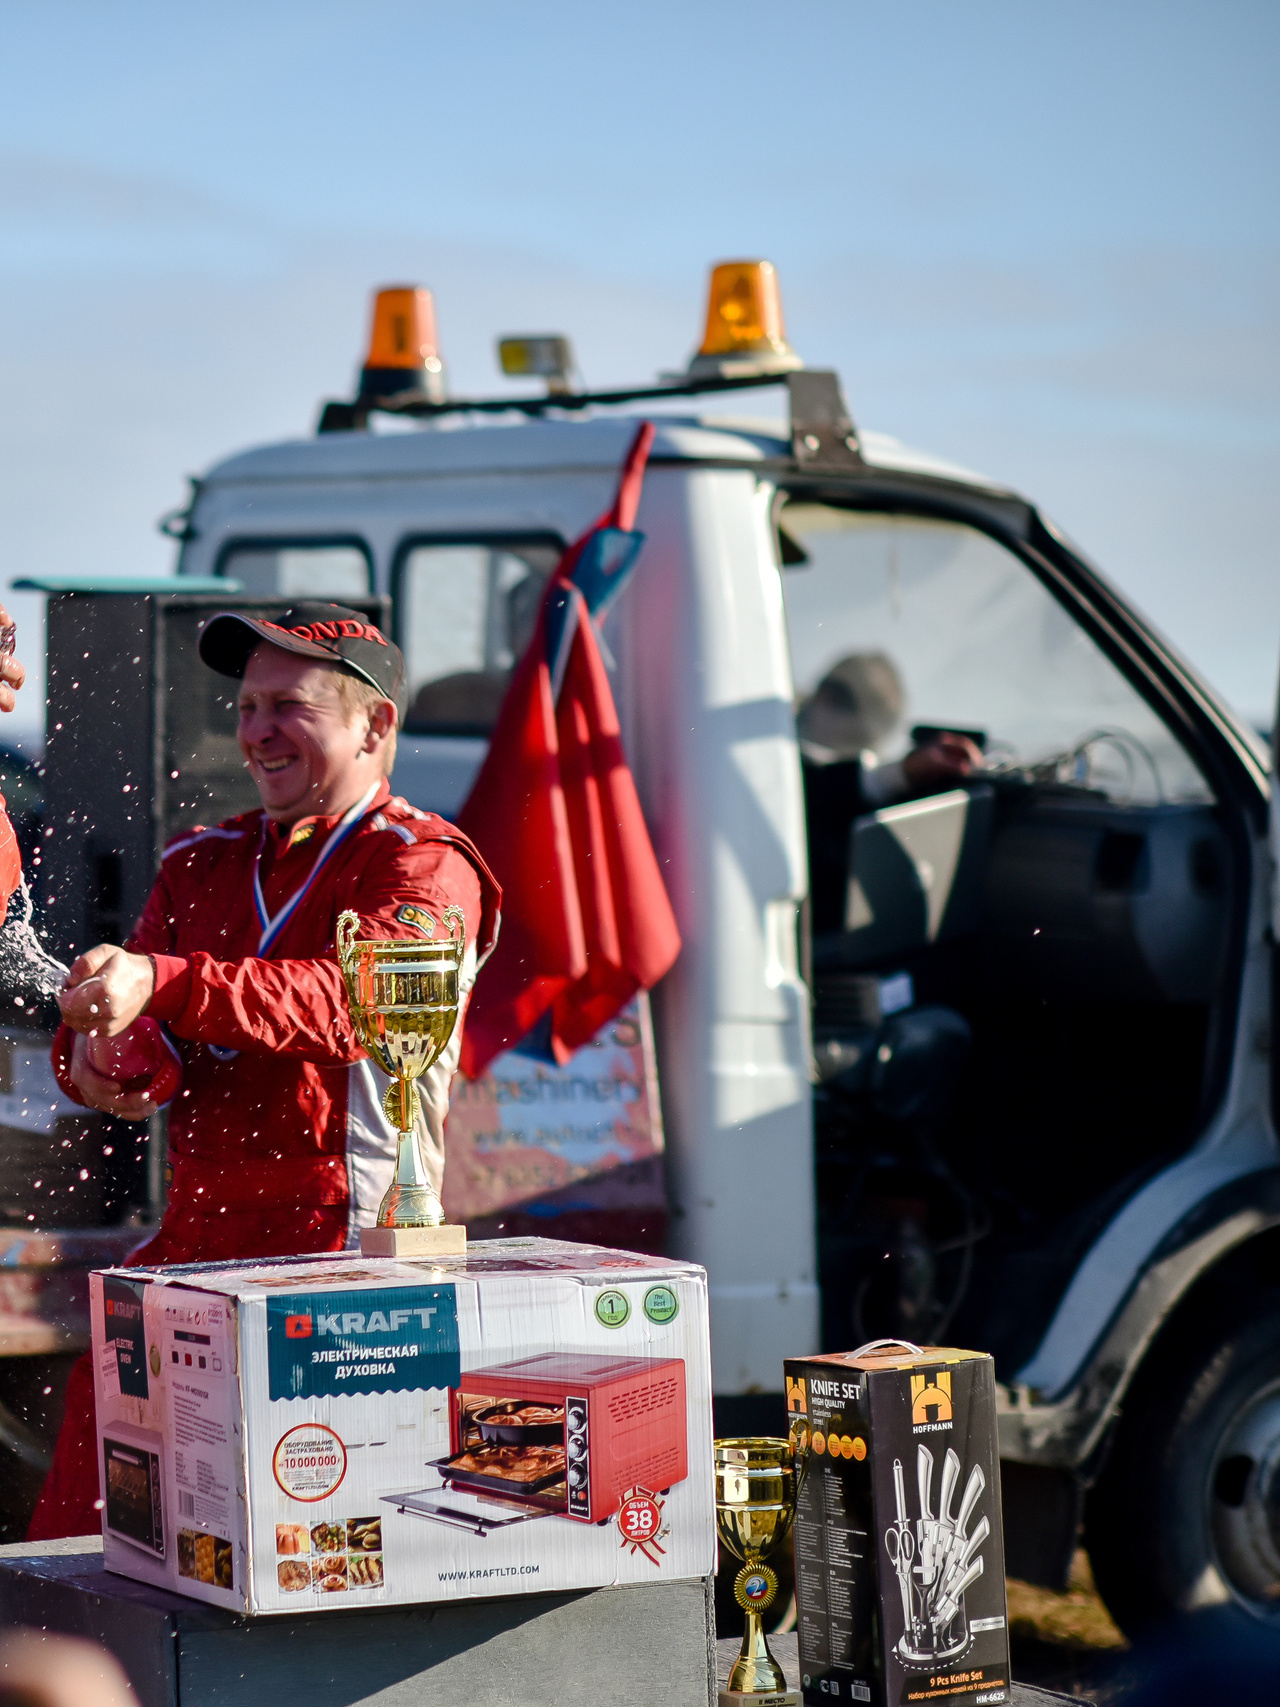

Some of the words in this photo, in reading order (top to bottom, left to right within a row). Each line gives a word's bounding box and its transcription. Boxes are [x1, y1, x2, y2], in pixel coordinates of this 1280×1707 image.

[259, 619, 389, 648] ONDA
[402, 908, 434, 930] OMP
[114, 1301, 142, 1321] KRAFT
[608, 1298, 615, 1315] 1
[650, 1306, 672, 1314] Product
[317, 1307, 437, 1337] KRAFT
[116, 1337, 134, 1351] ELECTRIC
[120, 1352, 132, 1364] OVEN
[311, 1344, 420, 1364] ЭЛЕКТРИЧЕСКАЯ
[335, 1362, 396, 1380] ДУХОВКА
[810, 1379, 840, 1398] KNIFE
[841, 1382, 861, 1400] SET
[811, 1397, 824, 1406] HIGH
[824, 1399, 846, 1409] QUALITY
[913, 1421, 953, 1434] HOFFMANN
[284, 1439, 335, 1449] ОБОРУДОВАНИЕ
[285, 1446, 334, 1456] ЗАСТРАХОВАНО
[629, 1501, 649, 1509] ОБЪЕМ
[626, 1509, 653, 1530] 38
[630, 1529, 651, 1537] ЛИТРОВ
[438, 1565, 540, 1582] WWW.KRAFTLTD.COM
[751, 1577, 762, 1597] 2
[930, 1678, 935, 1688] 9
[937, 1676, 949, 1687] Pcs
[950, 1672, 970, 1685] Knife
[970, 1671, 983, 1681] Set
[764, 1697, 786, 1705] МЕСТО
[908, 1691, 925, 1701] Набор
[976, 1691, 1005, 1705] HM-6625
